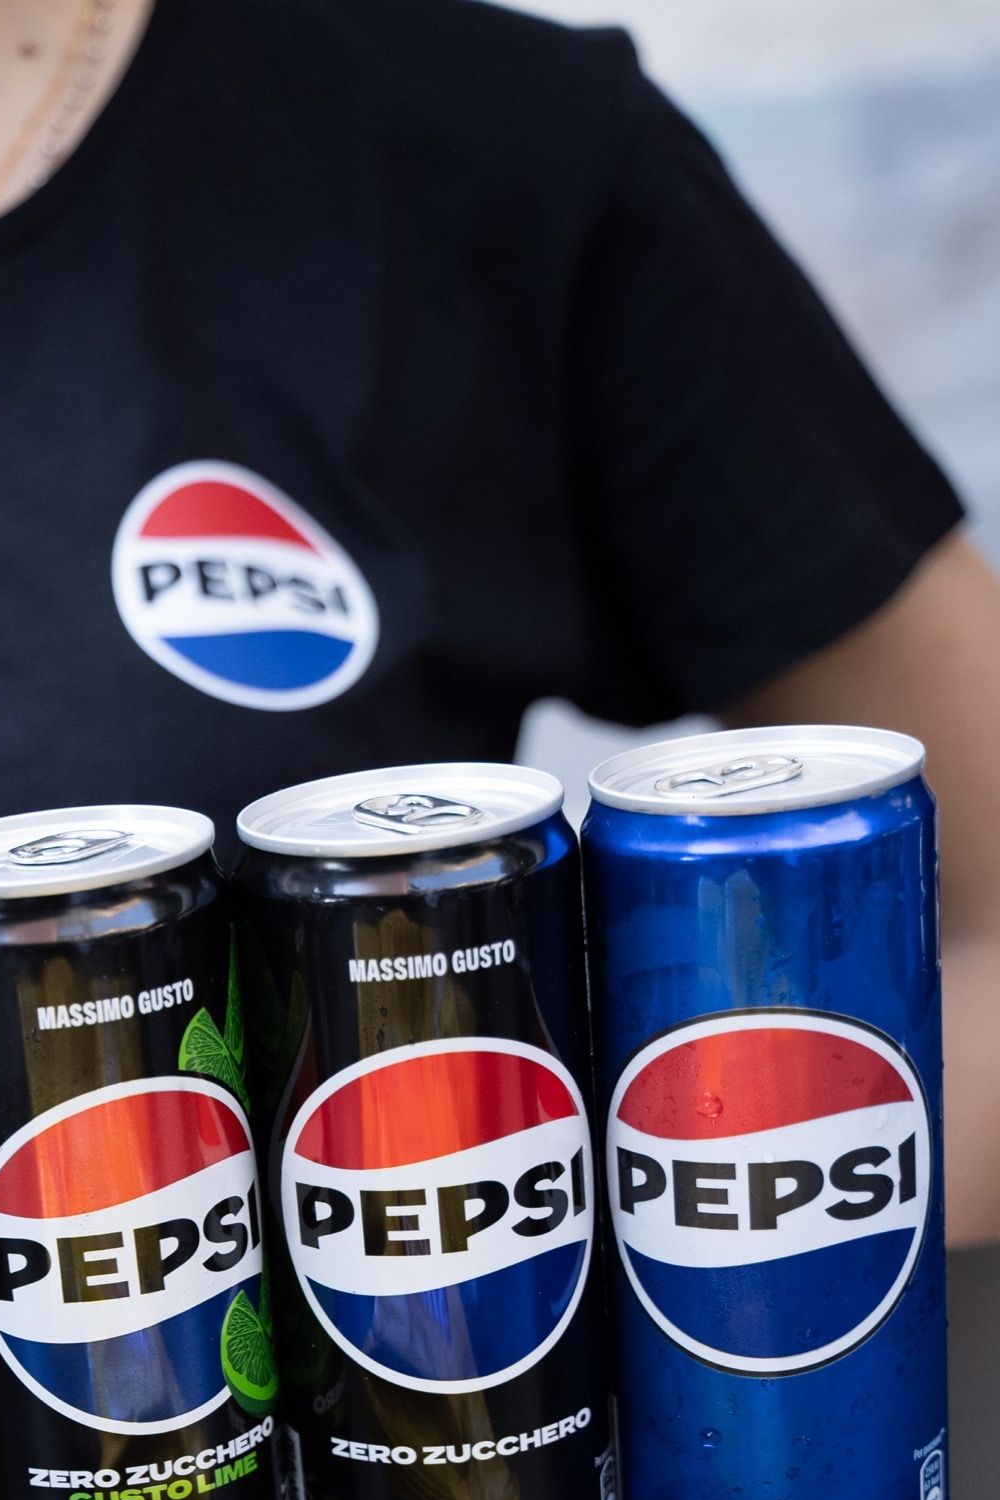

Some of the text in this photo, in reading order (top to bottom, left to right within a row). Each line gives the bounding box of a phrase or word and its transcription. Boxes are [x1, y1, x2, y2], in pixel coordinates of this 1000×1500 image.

[138, 558, 350, 617] PEPSI
[349, 938, 515, 983] MASSIMO GUSTO
[36, 978, 195, 1030] MASSIMO GUSTO
[294, 1143, 588, 1257] PEPSI
[615, 1130, 918, 1231] PEPSI
[27, 1414, 275, 1490] ZERO ZUCCHERO
[329, 1436, 418, 1466] ZERO
[422, 1406, 593, 1466] ZUCCHERO
[196, 1451, 259, 1494] LIME
